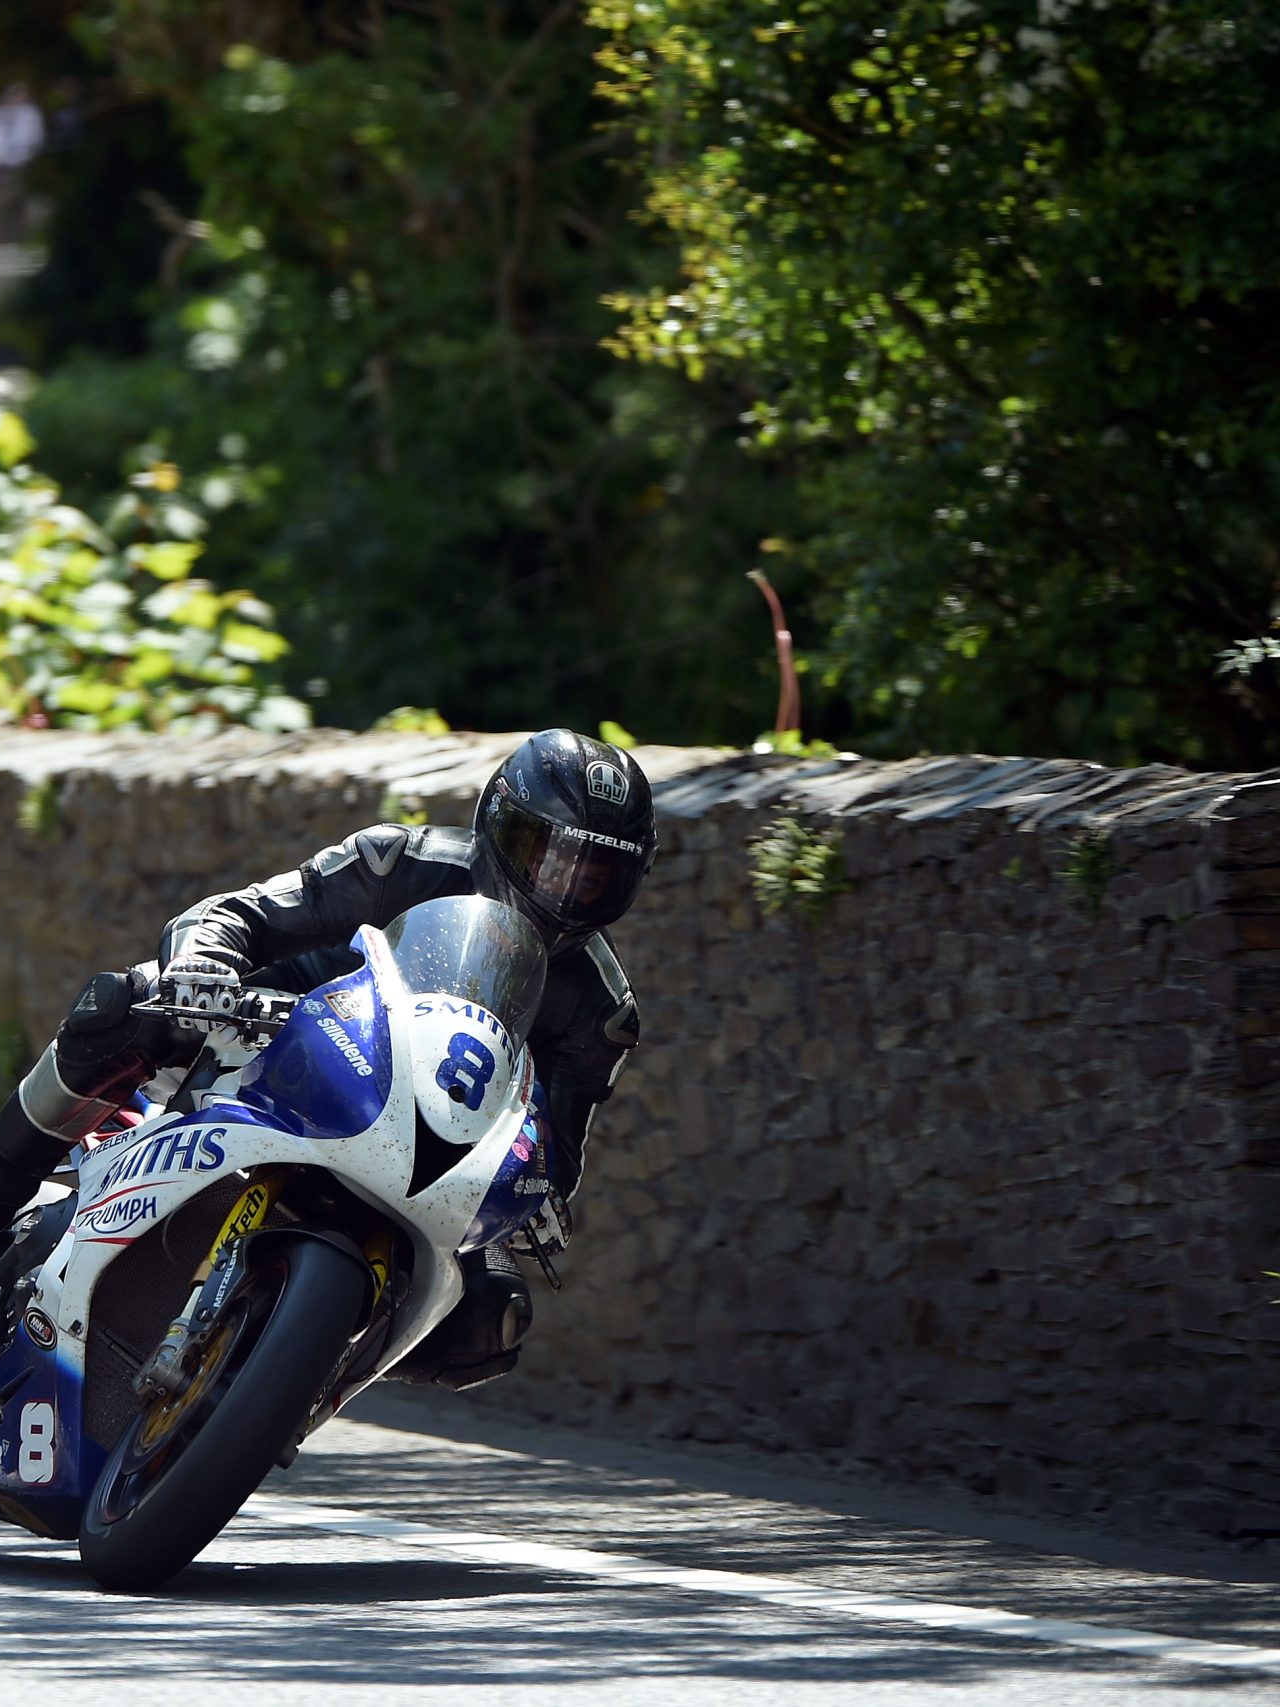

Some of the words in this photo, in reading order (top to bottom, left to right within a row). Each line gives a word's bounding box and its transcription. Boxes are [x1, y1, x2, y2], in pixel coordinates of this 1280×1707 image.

[564, 825, 636, 854] METZELER
[317, 1017, 373, 1077] Silkolene
[435, 1032, 495, 1111] 8
[80, 1131, 129, 1167] METZELER
[88, 1127, 228, 1201] SMITHS
[77, 1197, 157, 1234] TRIUMPH
[213, 1249, 239, 1308] METZELER
[18, 1401, 55, 1484] 8
